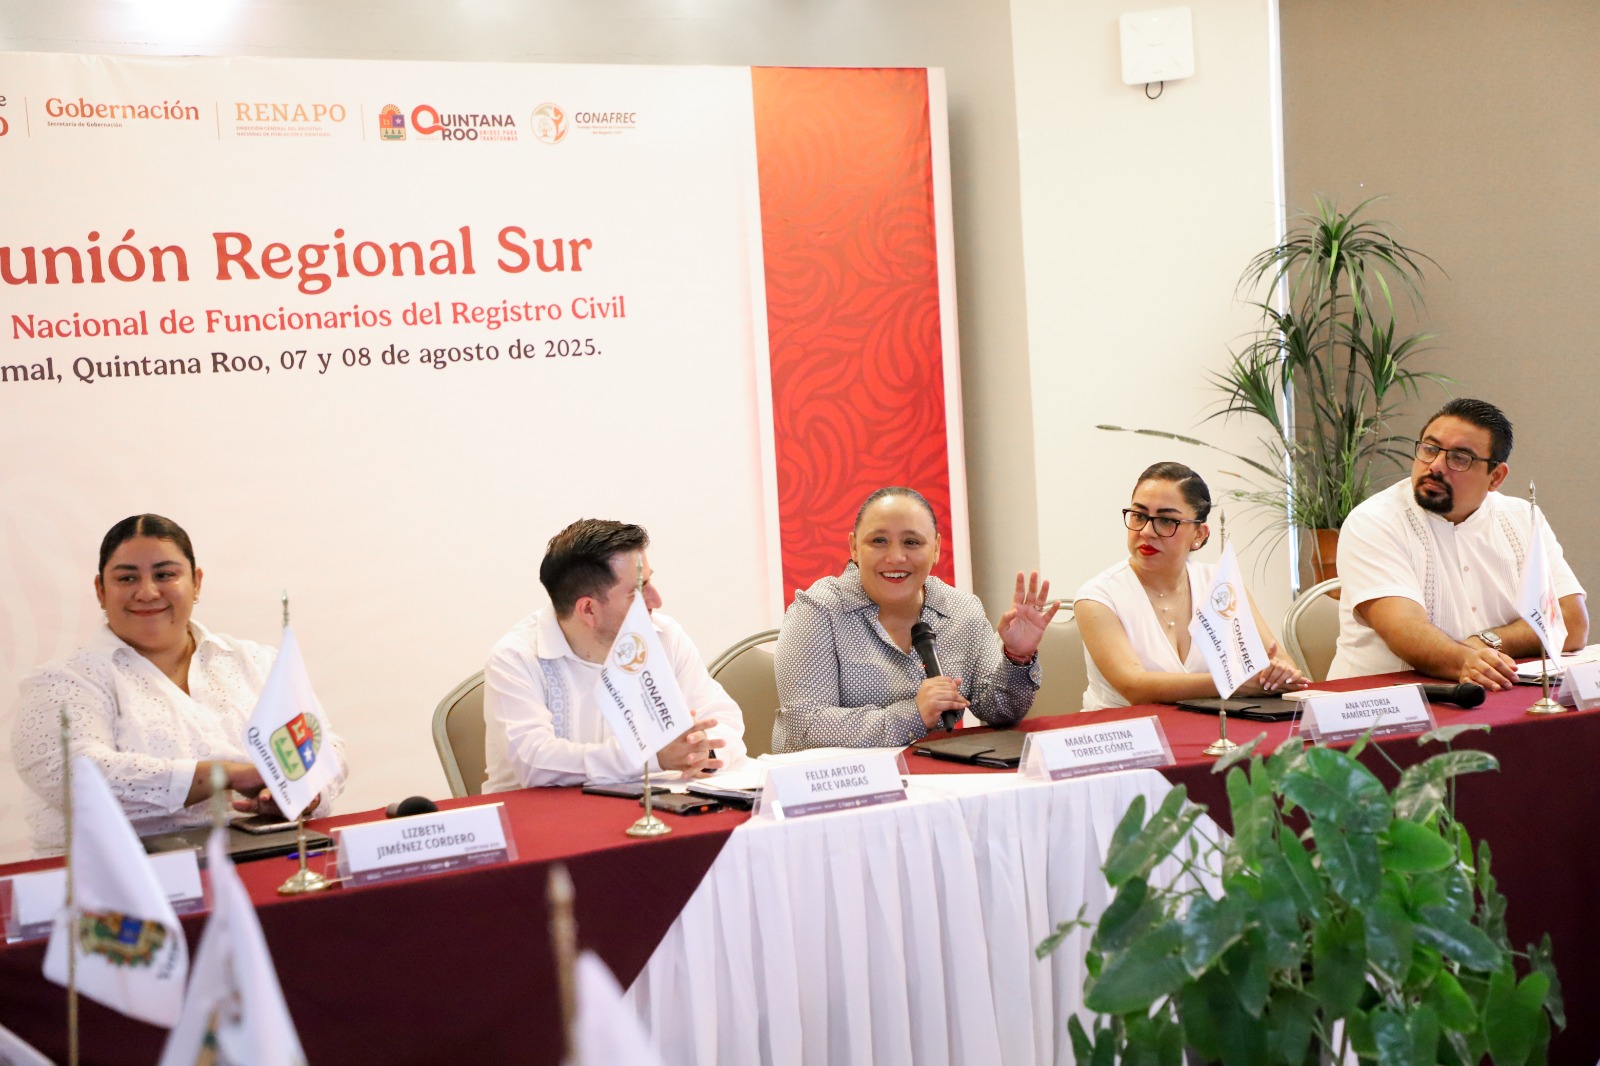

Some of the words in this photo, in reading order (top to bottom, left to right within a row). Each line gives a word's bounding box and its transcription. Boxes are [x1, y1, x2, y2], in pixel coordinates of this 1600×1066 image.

[45, 97, 200, 121] Gobernación
[234, 102, 347, 123] RENAPO
[411, 104, 516, 135] QUINTANA
[575, 112, 637, 124] CONAFREC
[441, 128, 478, 141] ROO
[0, 228, 190, 285] unión
[212, 225, 476, 295] Regional
[497, 225, 593, 273] Sur
[11, 310, 149, 339] Nacional
[159, 309, 195, 334] de
[205, 304, 392, 333] Funcionarios
[402, 301, 442, 326] del
[451, 299, 562, 330] Registro
[571, 295, 626, 319] Civil
[1, 357, 63, 384] mal,
[72, 355, 202, 384] Quintana
[211, 352, 271, 375] Roo,
[279, 350, 307, 370] 07
[317, 352, 332, 375] y
[342, 347, 372, 367] 08
[381, 344, 410, 366] de
[419, 342, 500, 370] agosto
[508, 339, 536, 359] de
[544, 338, 602, 358] 2025.
[1233, 617, 1255, 673] CONAFREC
[642, 670, 675, 731] CONAFREC
[1345, 701, 1360, 711] ANA
[1360, 698, 1391, 709] VICTORIA
[1341, 709, 1371, 720] RAMÍREZ
[623, 708, 647, 752] General
[1064, 734, 1095, 748] MARÍA
[1094, 729, 1134, 743] CRISTINA
[248, 726, 281, 780] Quintana
[1071, 746, 1104, 759] TORRES
[1105, 741, 1135, 753] GÓMEZ
[805, 769, 830, 781] FELIX
[831, 764, 866, 778] ARTURO
[811, 779, 834, 793] ARCE
[834, 776, 869, 789] VARGAS
[401, 823, 446, 840] LIZBETH
[376, 837, 423, 860] JIMÉNEZ
[424, 832, 476, 850] CORDERO
